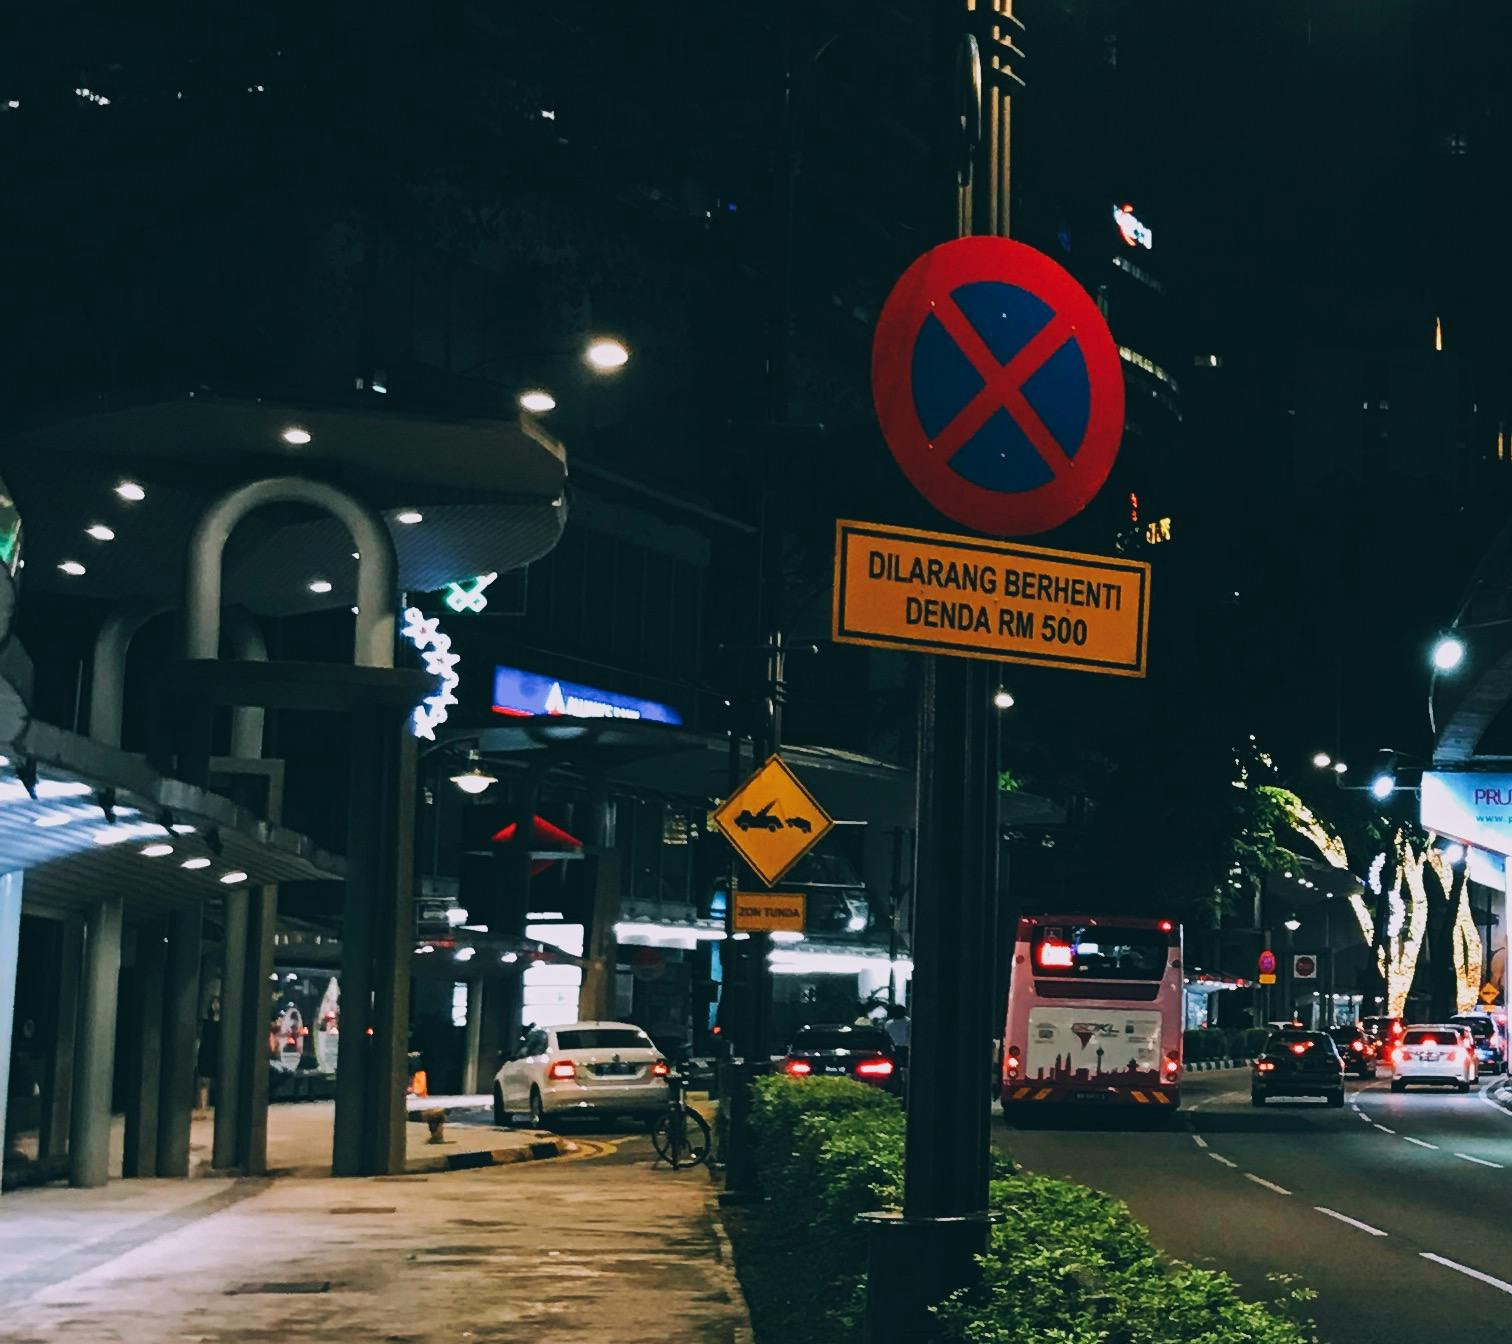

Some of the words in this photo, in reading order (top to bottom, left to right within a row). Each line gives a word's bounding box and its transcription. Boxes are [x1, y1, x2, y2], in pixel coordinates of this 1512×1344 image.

[868, 551, 997, 594] DILARANG
[1004, 569, 1121, 611] BERHENTI
[905, 597, 991, 633] DENDA
[998, 609, 1034, 639] RM
[1041, 615, 1087, 645] 500
